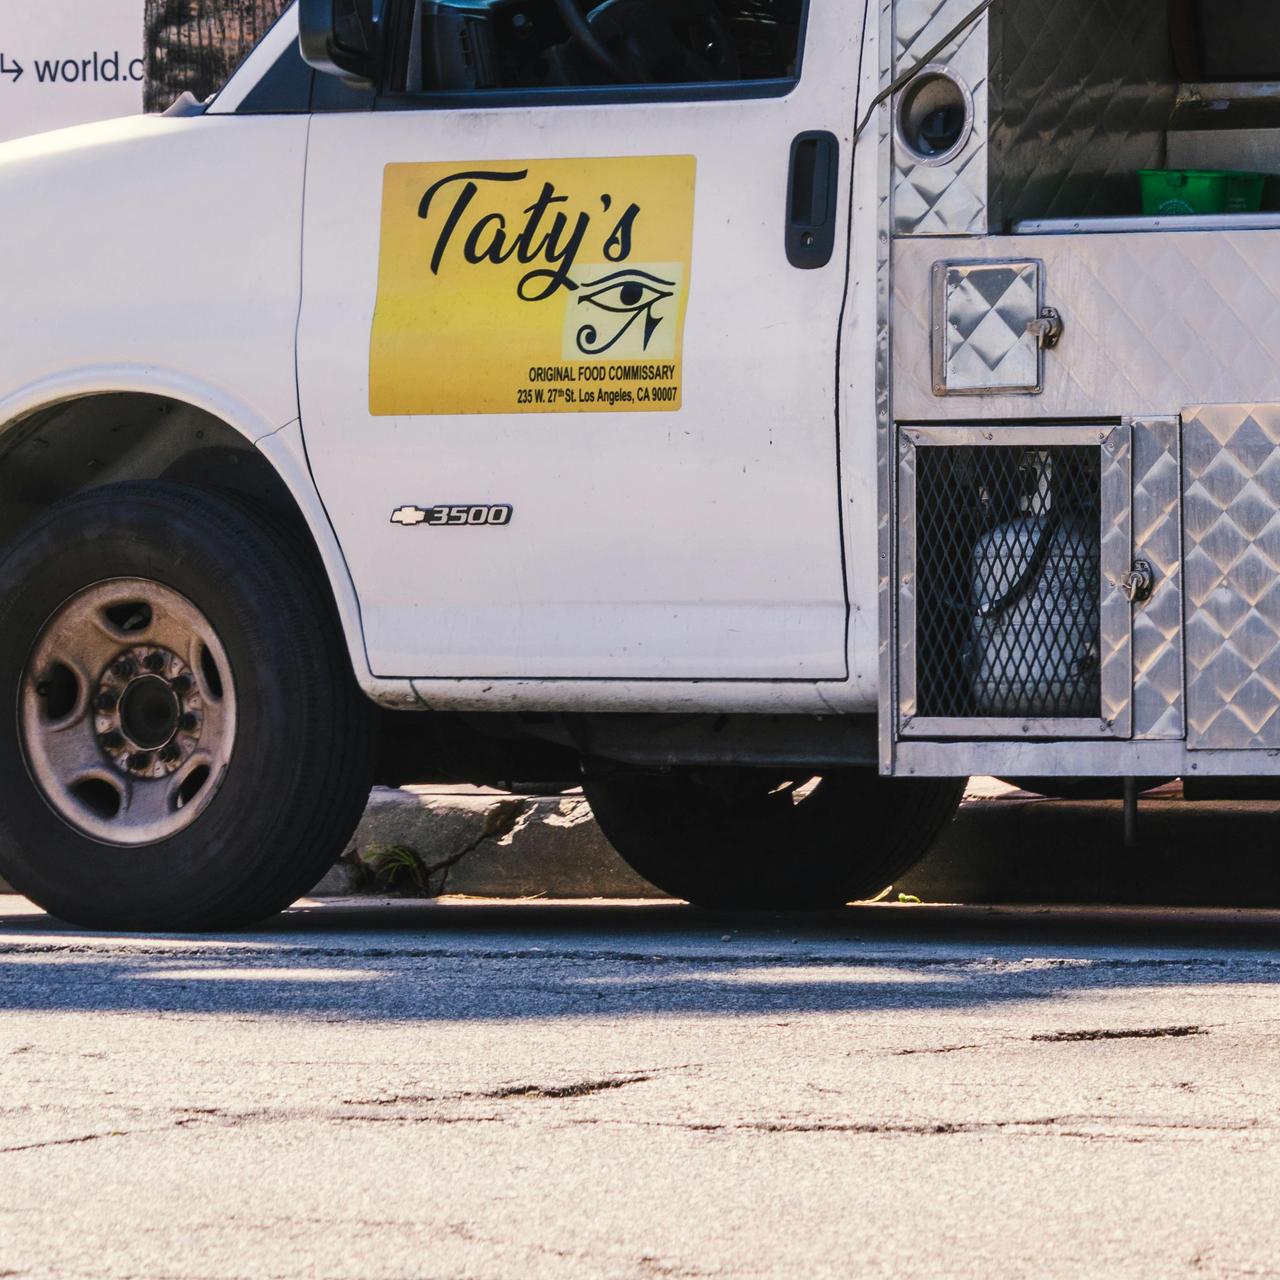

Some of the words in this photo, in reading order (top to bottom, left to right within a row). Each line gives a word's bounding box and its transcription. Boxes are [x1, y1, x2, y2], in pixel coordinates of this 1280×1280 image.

[417, 169, 641, 302] Taty's
[528, 367, 576, 382] ORIGINAL
[578, 366, 605, 381] FOOD
[608, 365, 676, 381] COMMISSARY
[517, 389, 533, 403] 235
[534, 389, 545, 403] W.
[547, 388, 564, 402] 27th
[565, 388, 576, 402] St.
[579, 388, 595, 402] Los
[597, 388, 635, 405] Angeles,
[637, 387, 650, 402] CA
[652, 387, 677, 402] 90007
[429, 506, 509, 524] 3500
